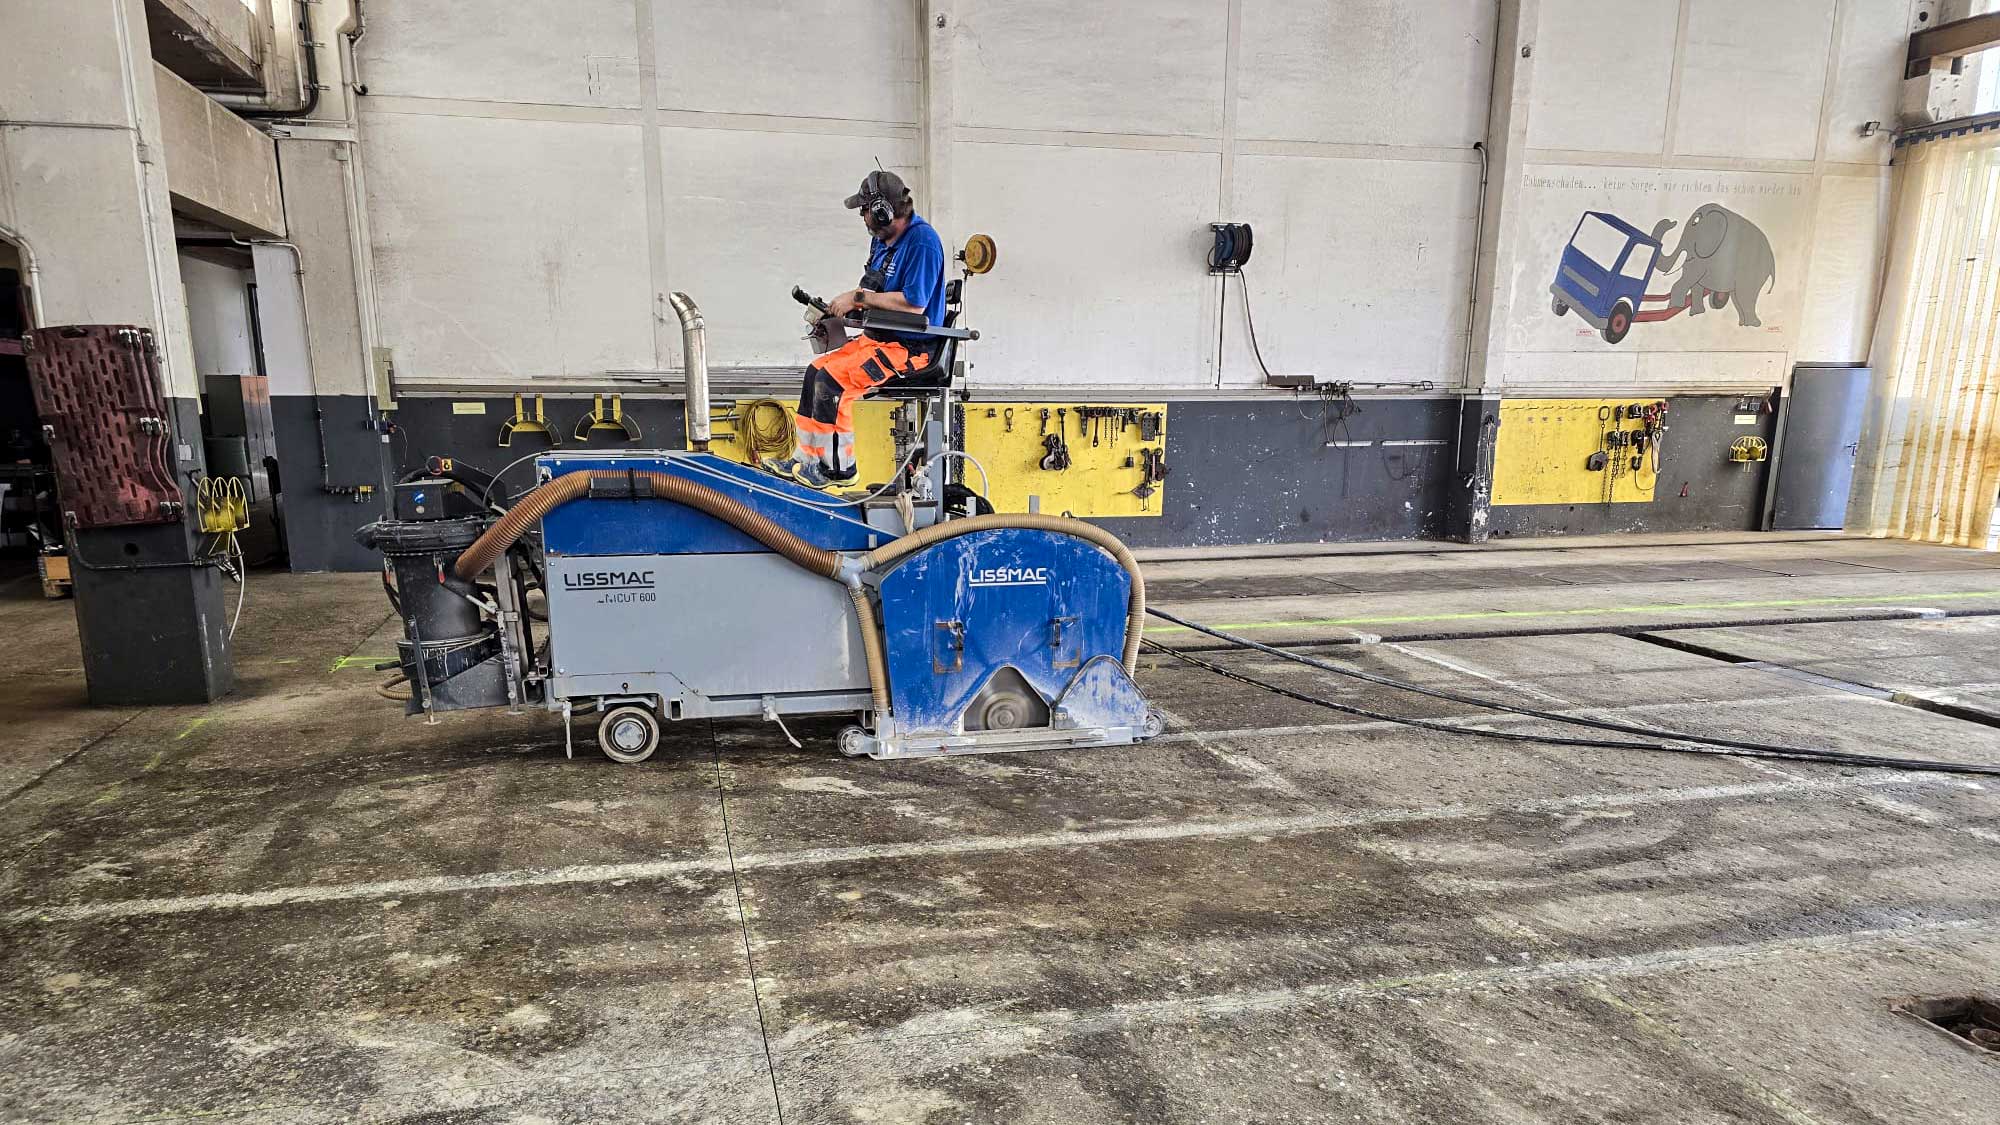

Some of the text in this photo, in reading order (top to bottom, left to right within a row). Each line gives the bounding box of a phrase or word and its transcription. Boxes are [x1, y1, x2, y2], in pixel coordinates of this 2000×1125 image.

[564, 571, 655, 587] LISSMAC
[968, 567, 1047, 582] LISSMAC
[598, 593, 656, 603] NICUT 600
